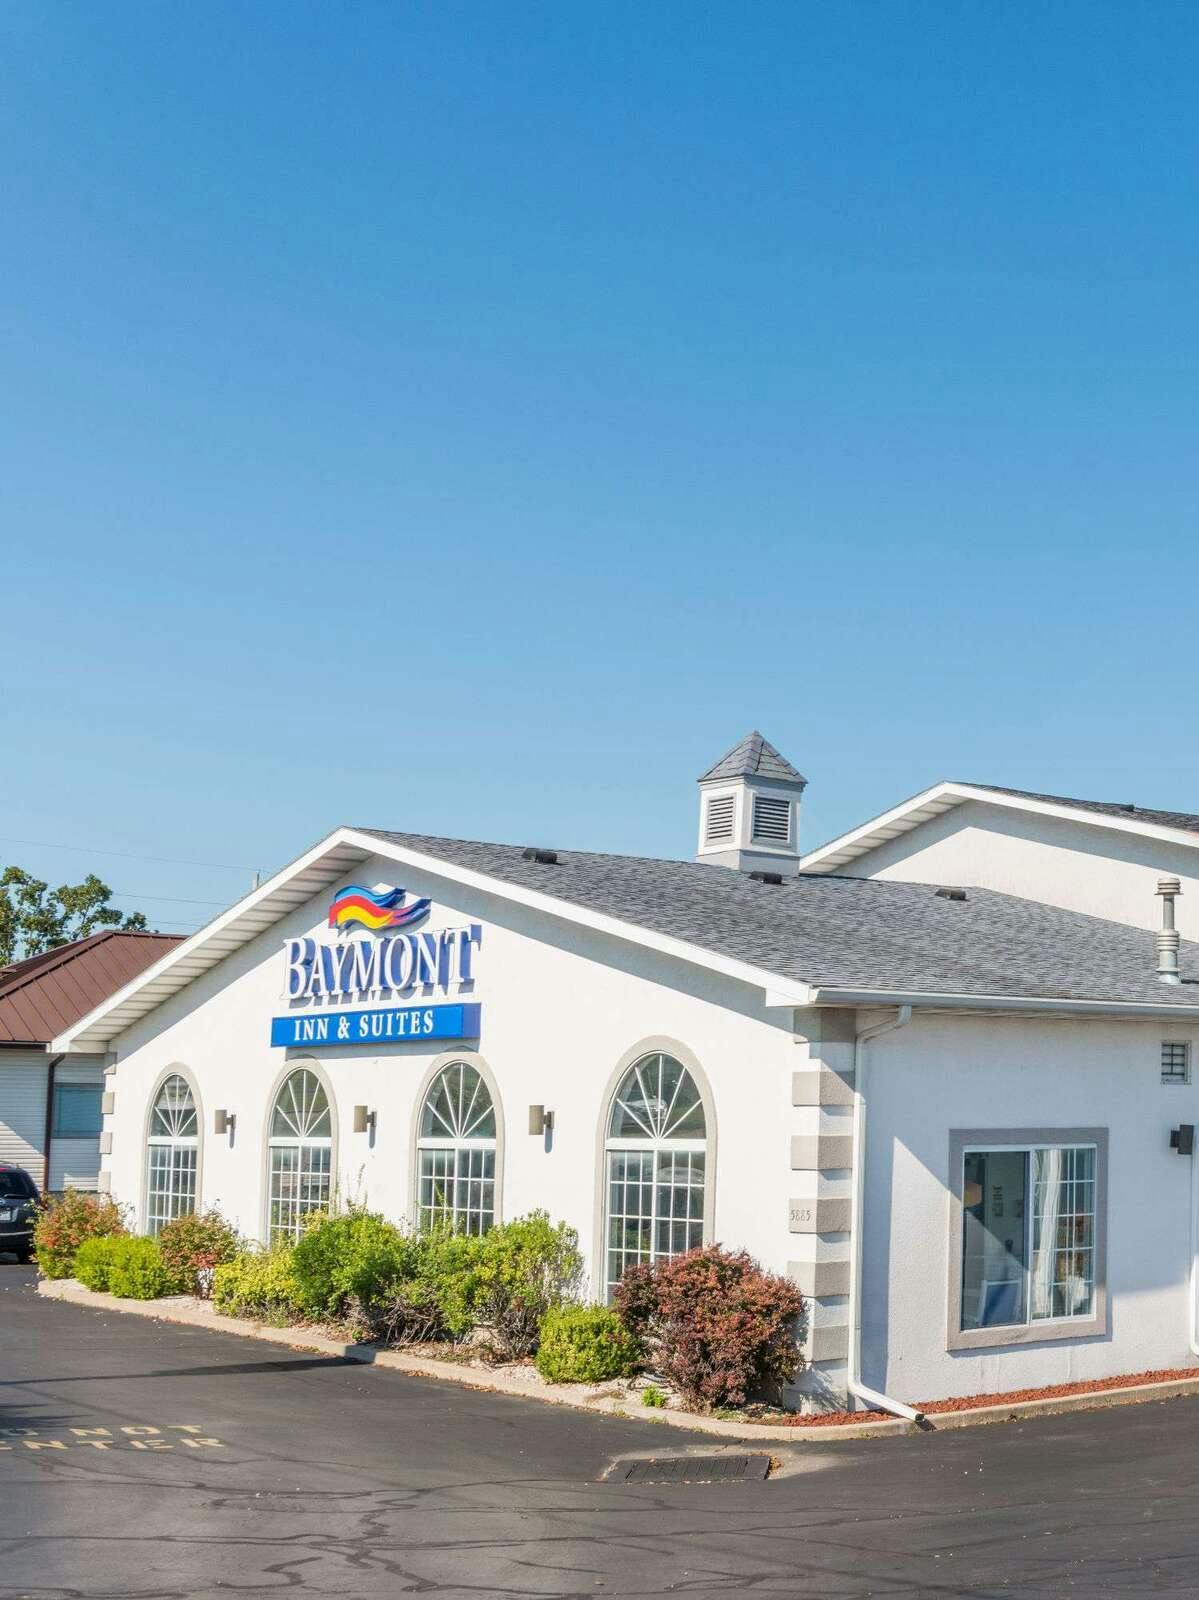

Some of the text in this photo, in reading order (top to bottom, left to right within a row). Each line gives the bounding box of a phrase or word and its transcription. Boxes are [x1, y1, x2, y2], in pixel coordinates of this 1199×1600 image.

[280, 926, 481, 999] BAYMONT
[294, 1009, 434, 1041] INN & SUITES
[68, 1424, 201, 1437] NOT
